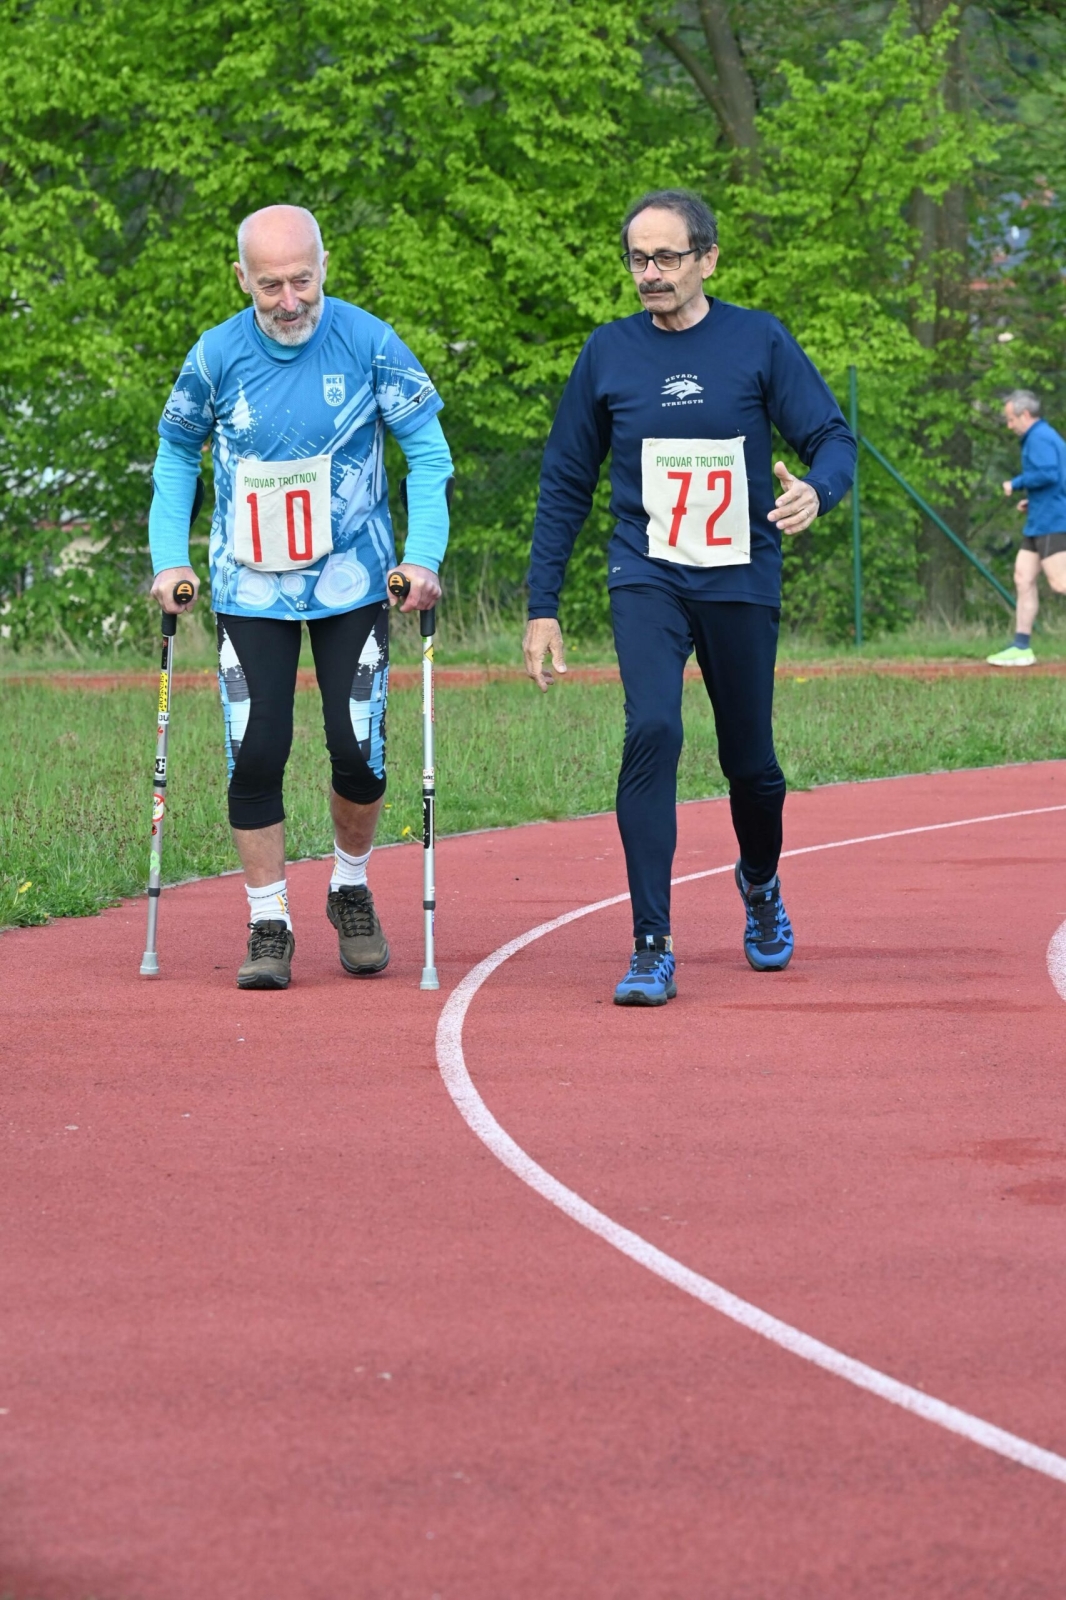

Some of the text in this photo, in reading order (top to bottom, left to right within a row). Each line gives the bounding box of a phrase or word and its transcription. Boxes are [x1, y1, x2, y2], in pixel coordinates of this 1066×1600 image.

[665, 374, 698, 383] NEVADA
[661, 399, 704, 407] STRENGTH
[656, 455, 735, 467] PIVOVAR TRUTNOV
[244, 472, 317, 488] PIVOVAR TRUTNOV
[667, 470, 732, 547] 72
[246, 489, 313, 562] 10
